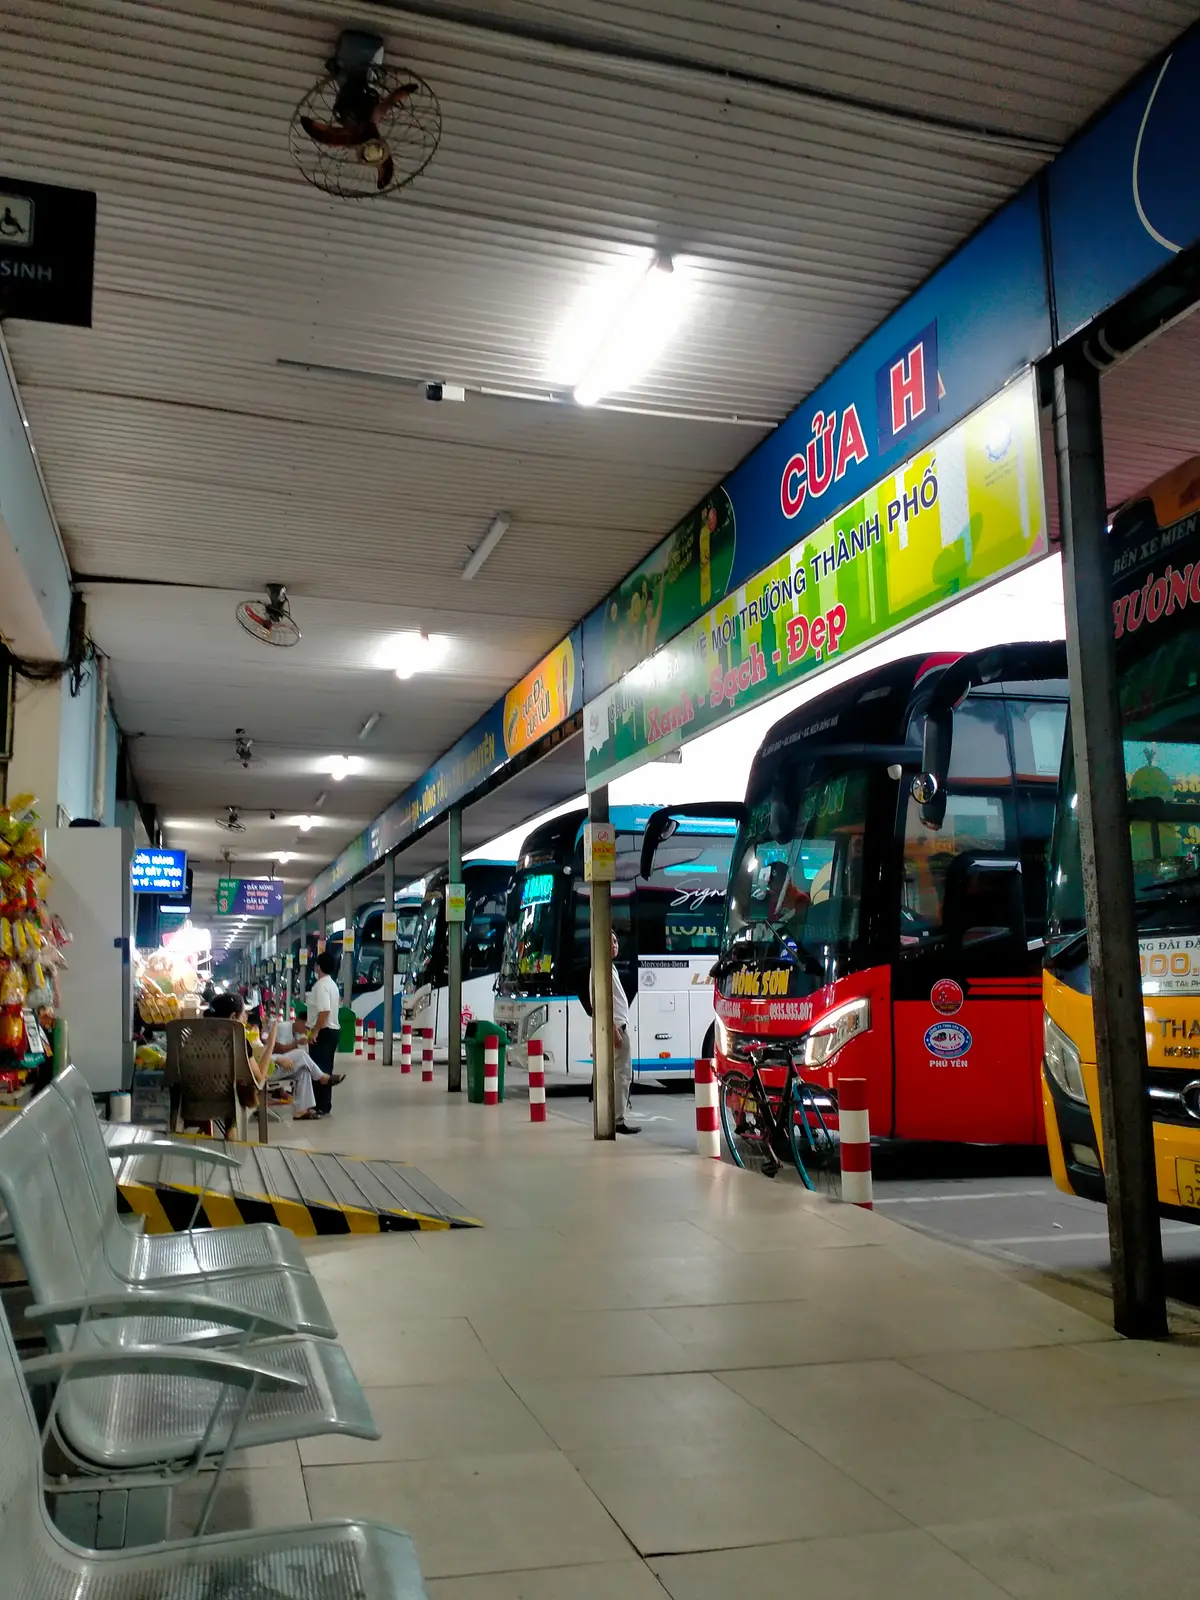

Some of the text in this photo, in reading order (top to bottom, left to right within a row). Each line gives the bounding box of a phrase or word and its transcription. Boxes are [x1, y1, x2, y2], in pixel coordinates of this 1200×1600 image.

[0, 258, 52, 282] SINH
[781, 341, 926, 519] CỬA H
[711, 616, 736, 651] MÔI
[740, 567, 806, 631] TRƯỜNG
[810, 514, 881, 582] THÀNH
[886, 458, 939, 534] PHỐ
[1139, 536, 1160, 561] XE
[646, 690, 694, 744] Xanh
[709, 642, 766, 708] Sạch
[786, 603, 847, 664] Đẹp
[219, 898, 228, 912] 3
[640, 960, 688, 968] Mercedes-Benz
[760, 967, 790, 996] SƠN
